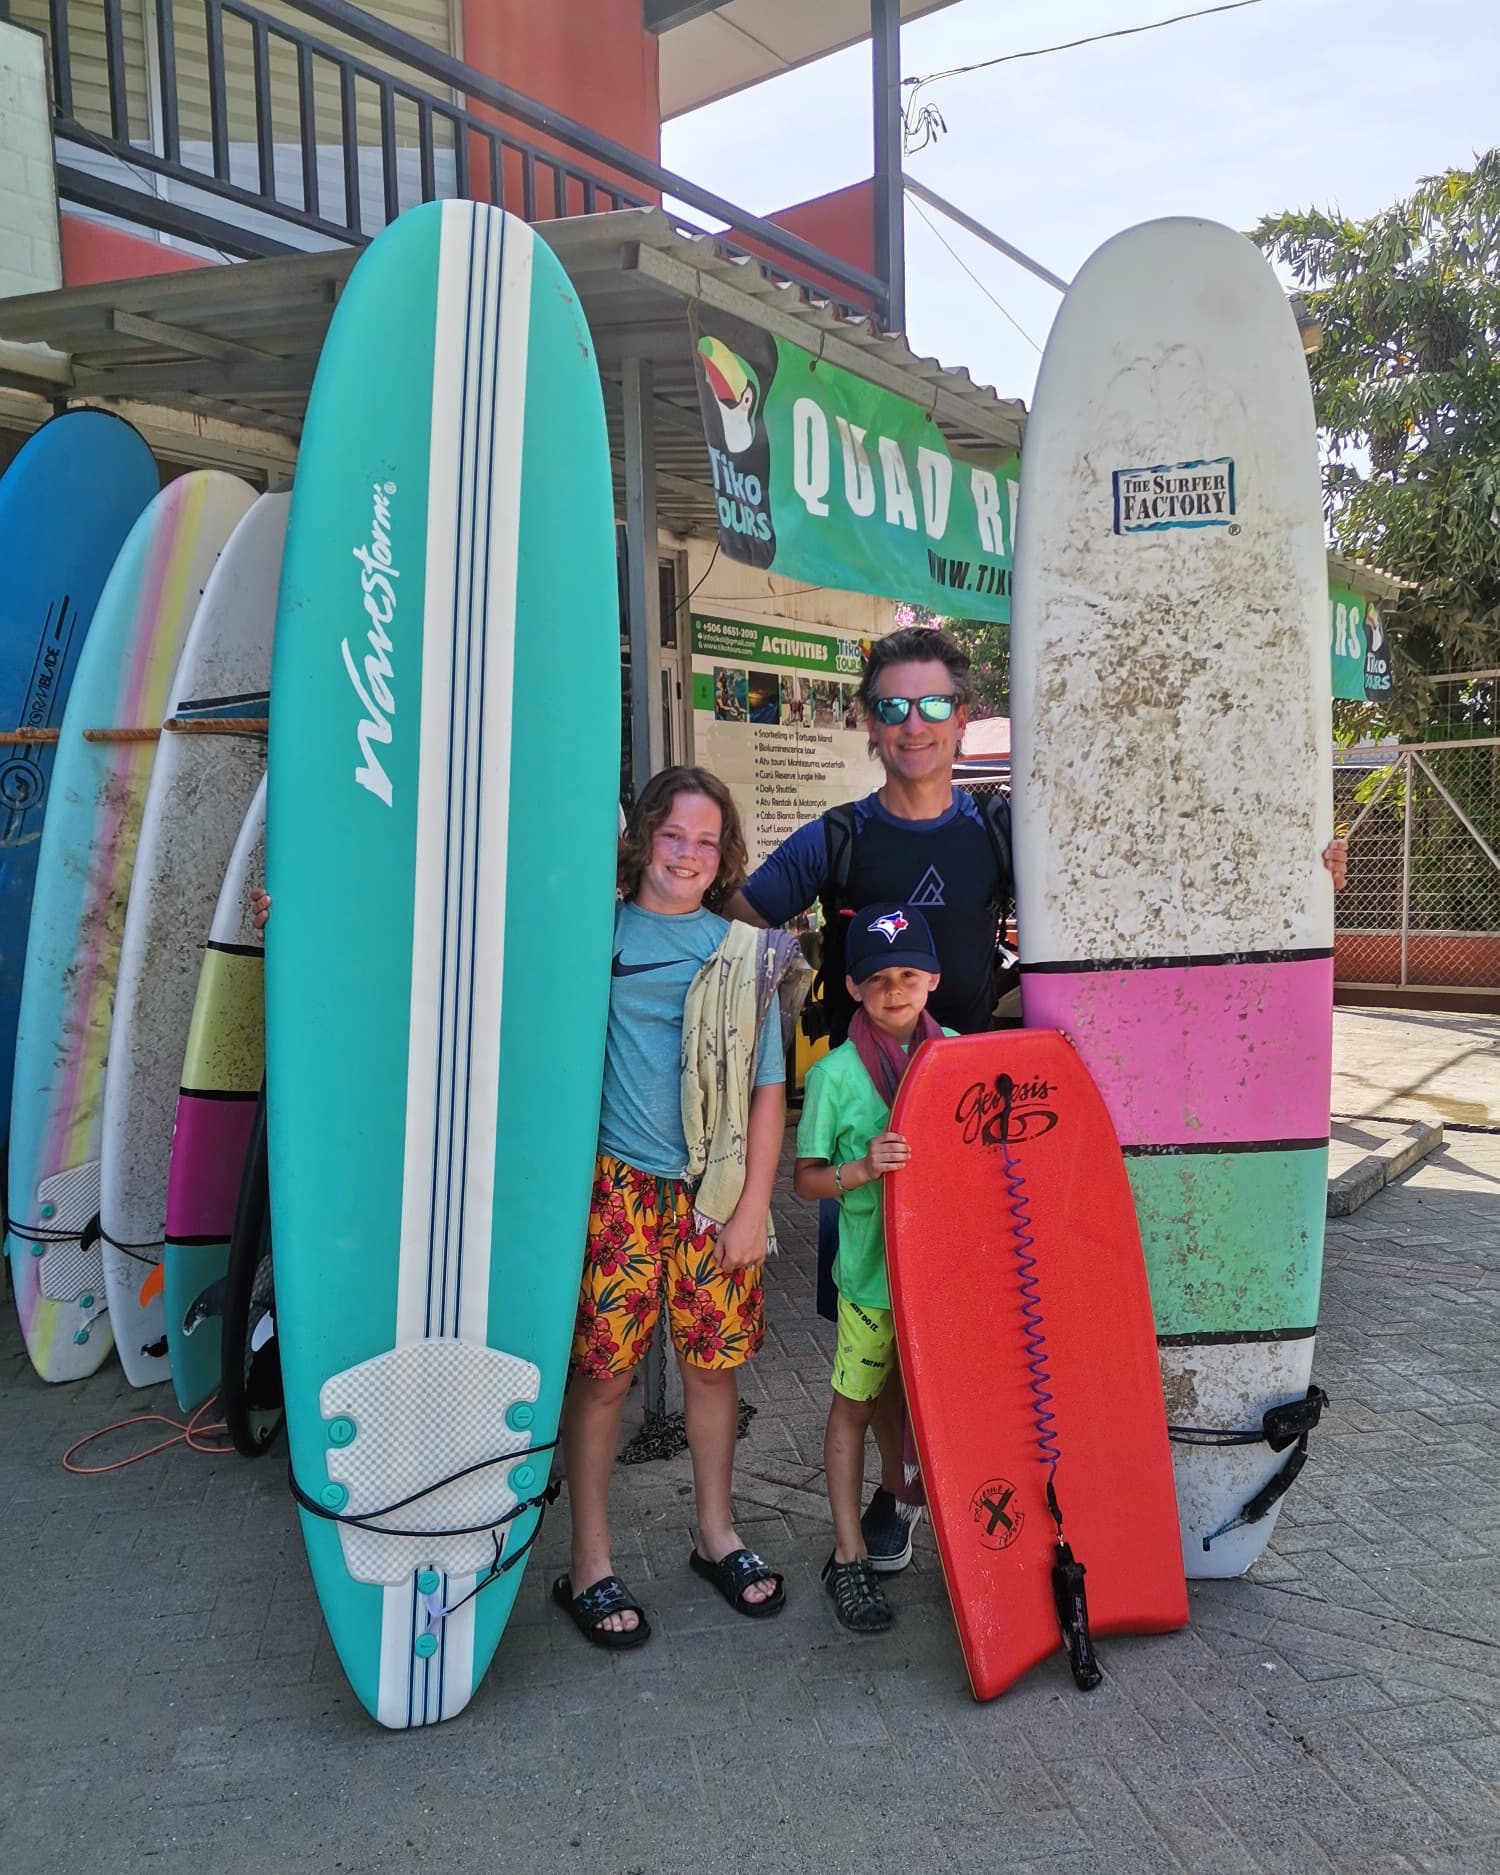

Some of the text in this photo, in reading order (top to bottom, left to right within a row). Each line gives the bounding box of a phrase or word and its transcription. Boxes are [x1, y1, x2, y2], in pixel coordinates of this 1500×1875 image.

[709, 446, 762, 506] Tiko
[793, 397, 953, 540] QUAD
[1124, 474, 1226, 495] THE SURFER
[1124, 491, 1227, 521] FACTORY
[716, 496, 772, 541] OURS
[703, 622, 722, 635] +506
[761, 635, 829, 663] ACTIVITIES
[837, 639, 861, 658] Tiko
[774, 770, 796, 780] Reserve
[760, 822, 773, 833] Surf
